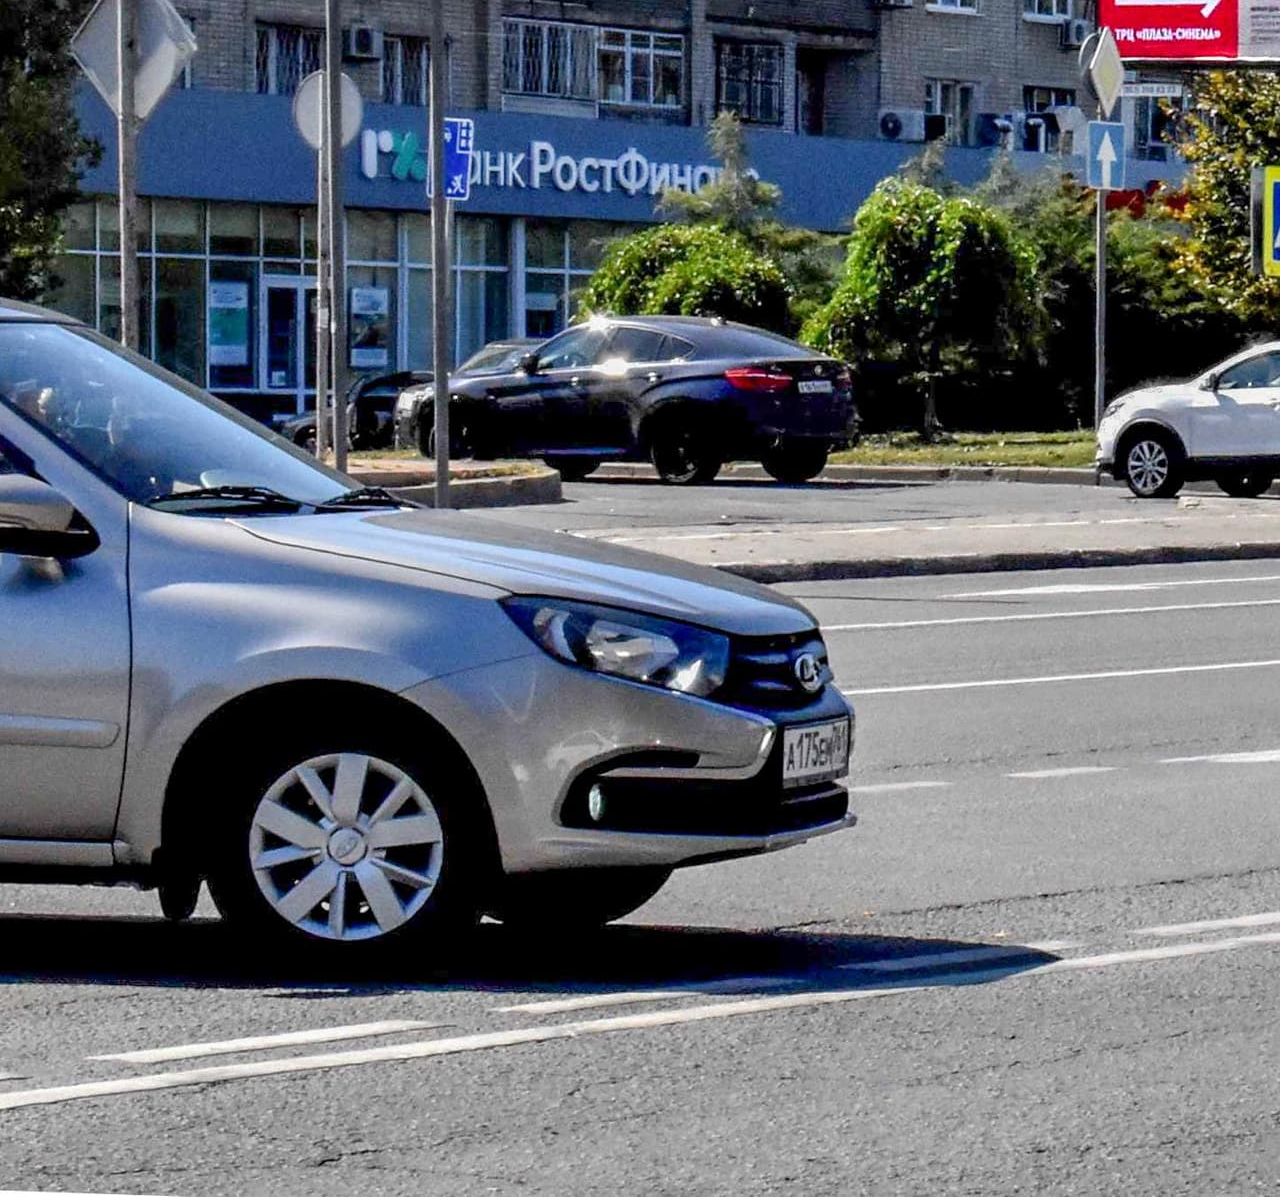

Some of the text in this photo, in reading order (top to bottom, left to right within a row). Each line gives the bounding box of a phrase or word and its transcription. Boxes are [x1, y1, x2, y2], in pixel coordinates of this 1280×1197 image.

[1114, 28, 1135, 42] ТРЦ
[468, 140, 760, 197] анк РостФина
